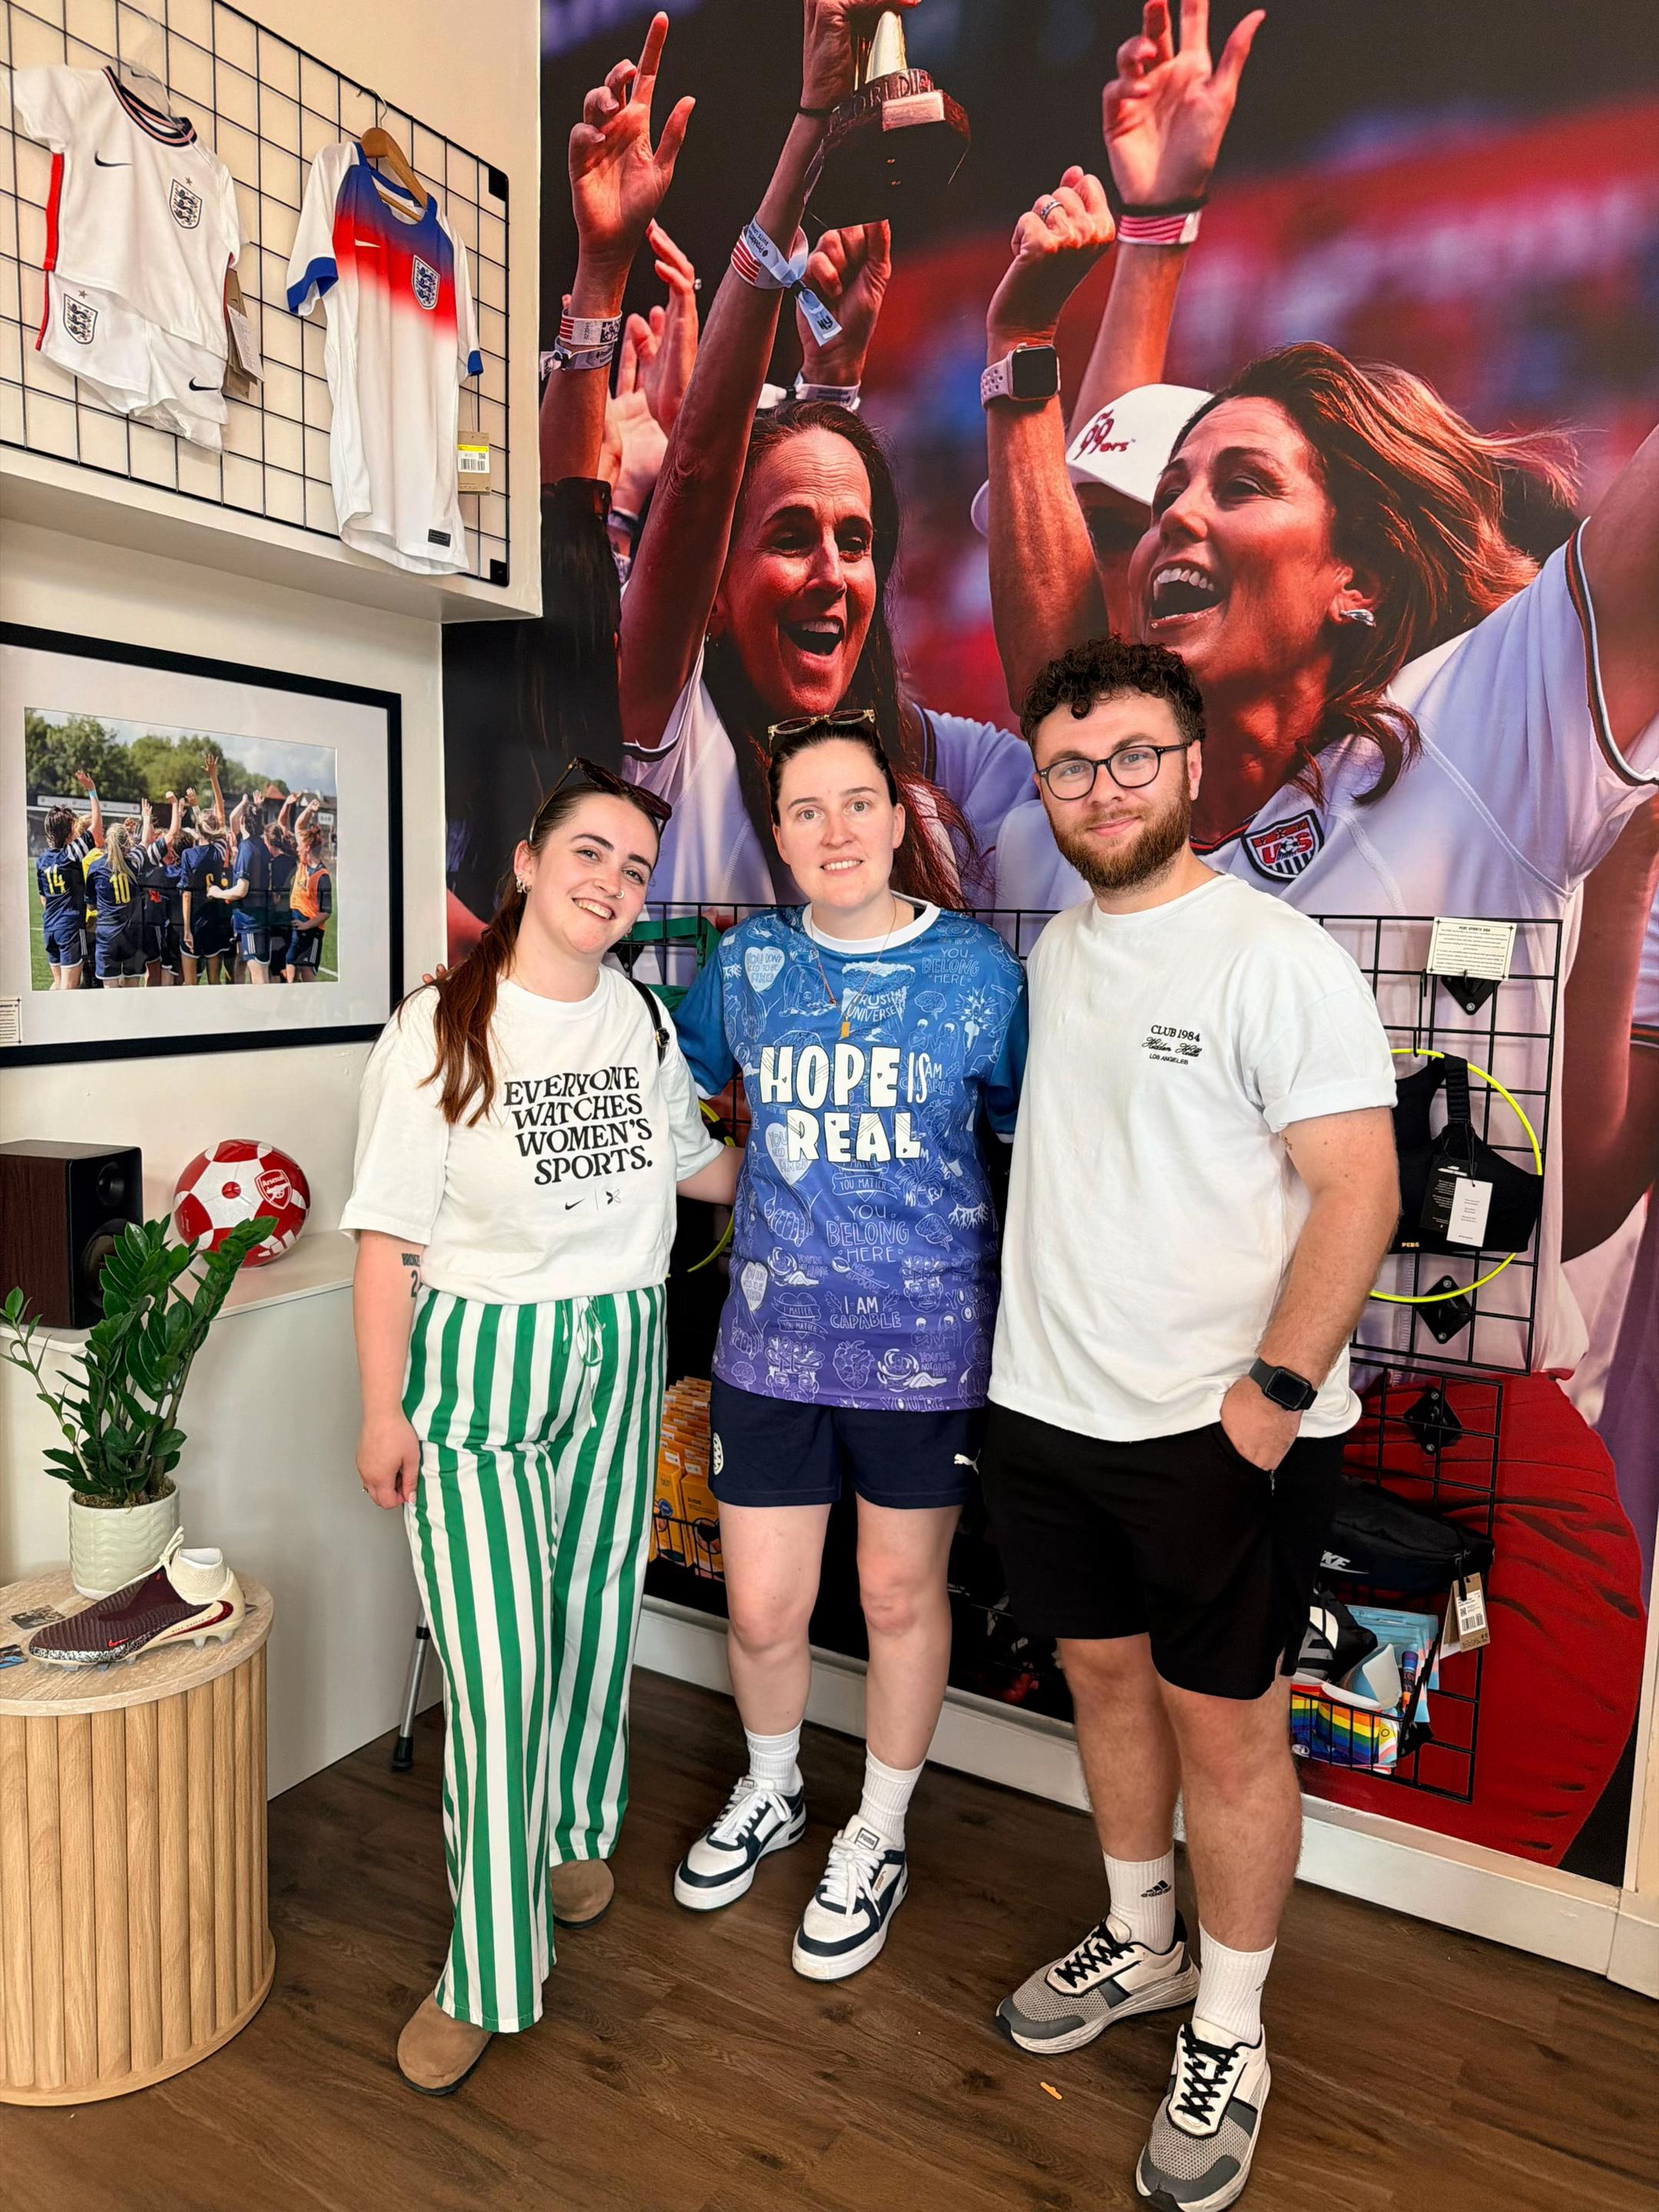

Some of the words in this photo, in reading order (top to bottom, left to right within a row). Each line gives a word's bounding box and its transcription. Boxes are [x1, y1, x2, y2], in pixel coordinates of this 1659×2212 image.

[44, 866, 65, 895] 14
[109, 873, 131, 905] 10
[941, 948, 968, 959] YOU
[922, 957, 980, 977] BELONG
[847, 1005, 897, 1022] UNIVERSE
[1151, 1025, 1177, 1038] CLUB
[1177, 1029, 1200, 1042] 1984
[1161, 1055, 1189, 1065] ANGELES
[760, 1043, 901, 1109] HOPE
[907, 1051, 931, 1104] IS
[504, 1066, 640, 1106] EVERYONE
[512, 1094, 642, 1130] WATCHES
[515, 1118, 652, 1157] WOMEN'S
[786, 1109, 921, 1162] REAL
[534, 1145, 653, 1185] SPORTS.
[262, 1174, 286, 1187] Arsenal
[840, 1179, 854, 1191] YOU
[858, 1178, 887, 1191] MATTER
[847, 1204, 886, 1220] YOU
[826, 1220, 909, 1247] BELONG
[846, 1246, 897, 1263] HERE
[851, 1261, 874, 1277] NEED
[789, 1306, 813, 1316] MATTER
[845, 1296, 849, 1314] I
[856, 1296, 879, 1315] AM
[830, 1311, 902, 1330] CAPABLE
[1320, 1550, 1351, 1570] KE
[1141, 1885, 1171, 1897] adidas
